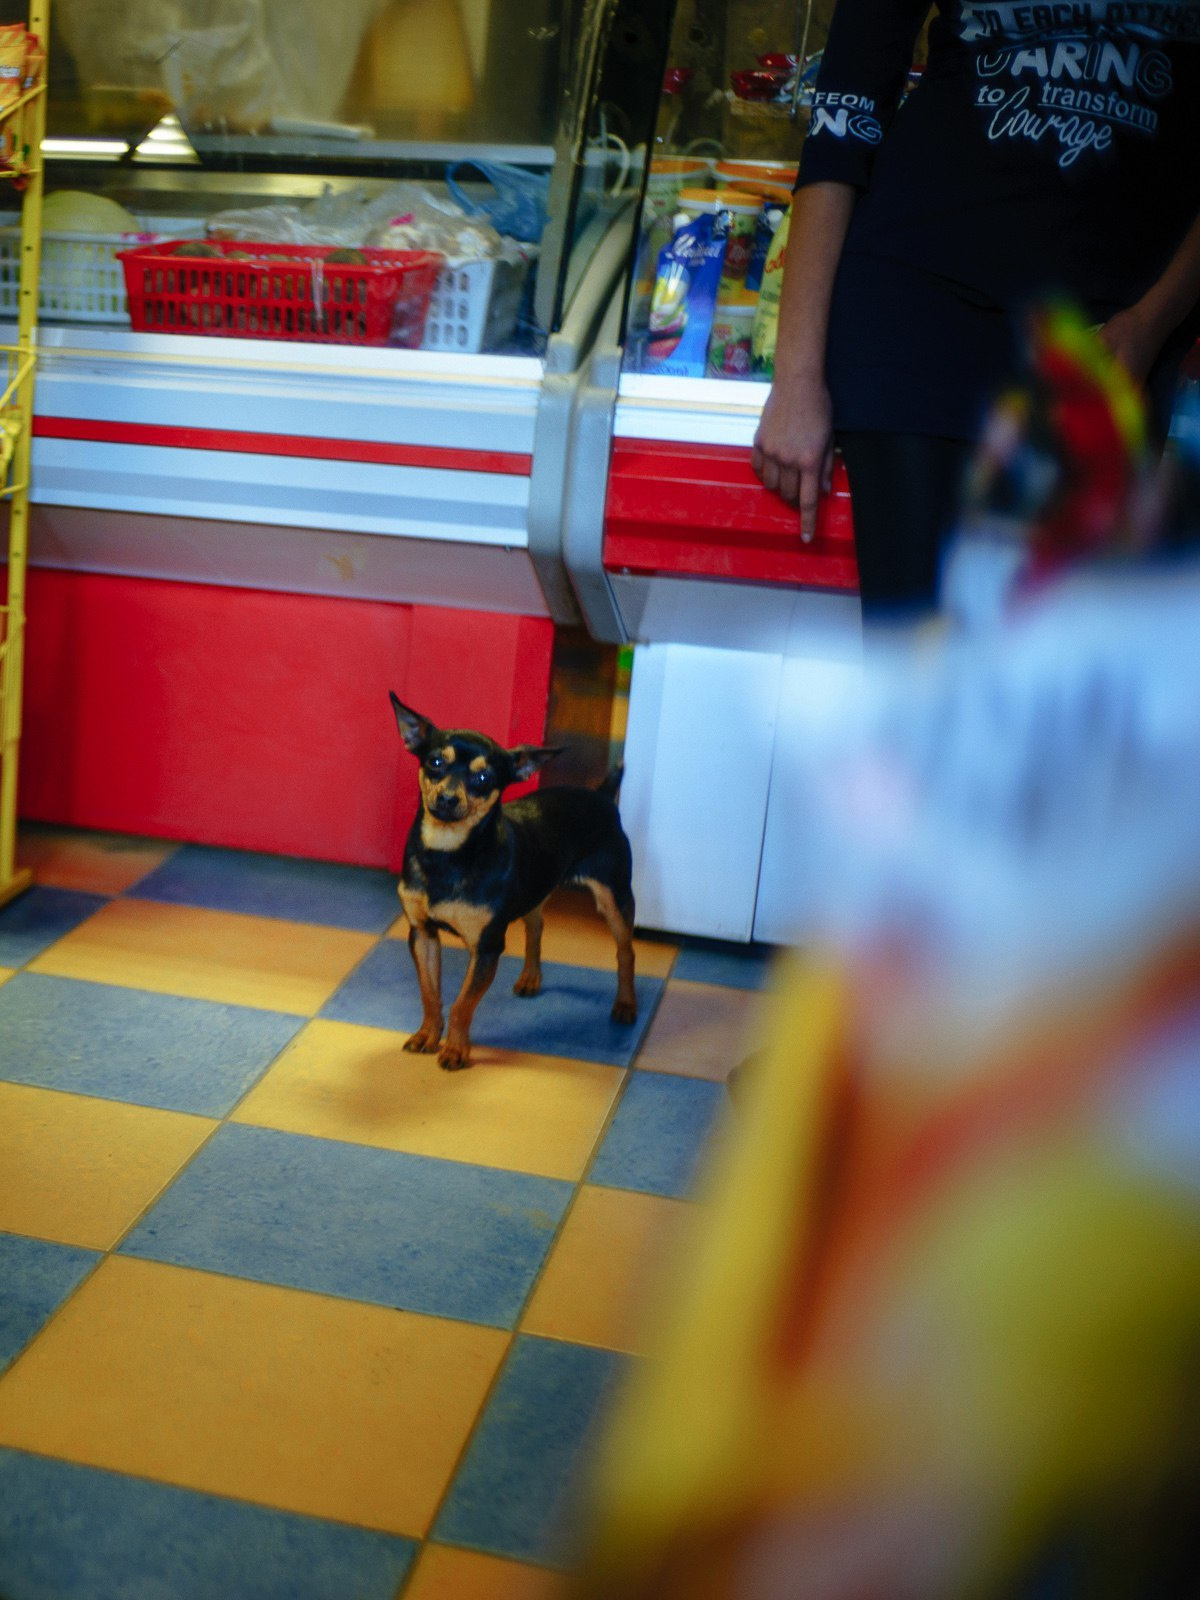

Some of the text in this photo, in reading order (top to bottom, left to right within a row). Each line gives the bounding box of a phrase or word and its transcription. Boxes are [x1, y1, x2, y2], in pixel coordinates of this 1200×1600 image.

[976, 41, 1173, 97] DARING
[978, 82, 1160, 132] to transform
[988, 85, 1113, 168] Courage
